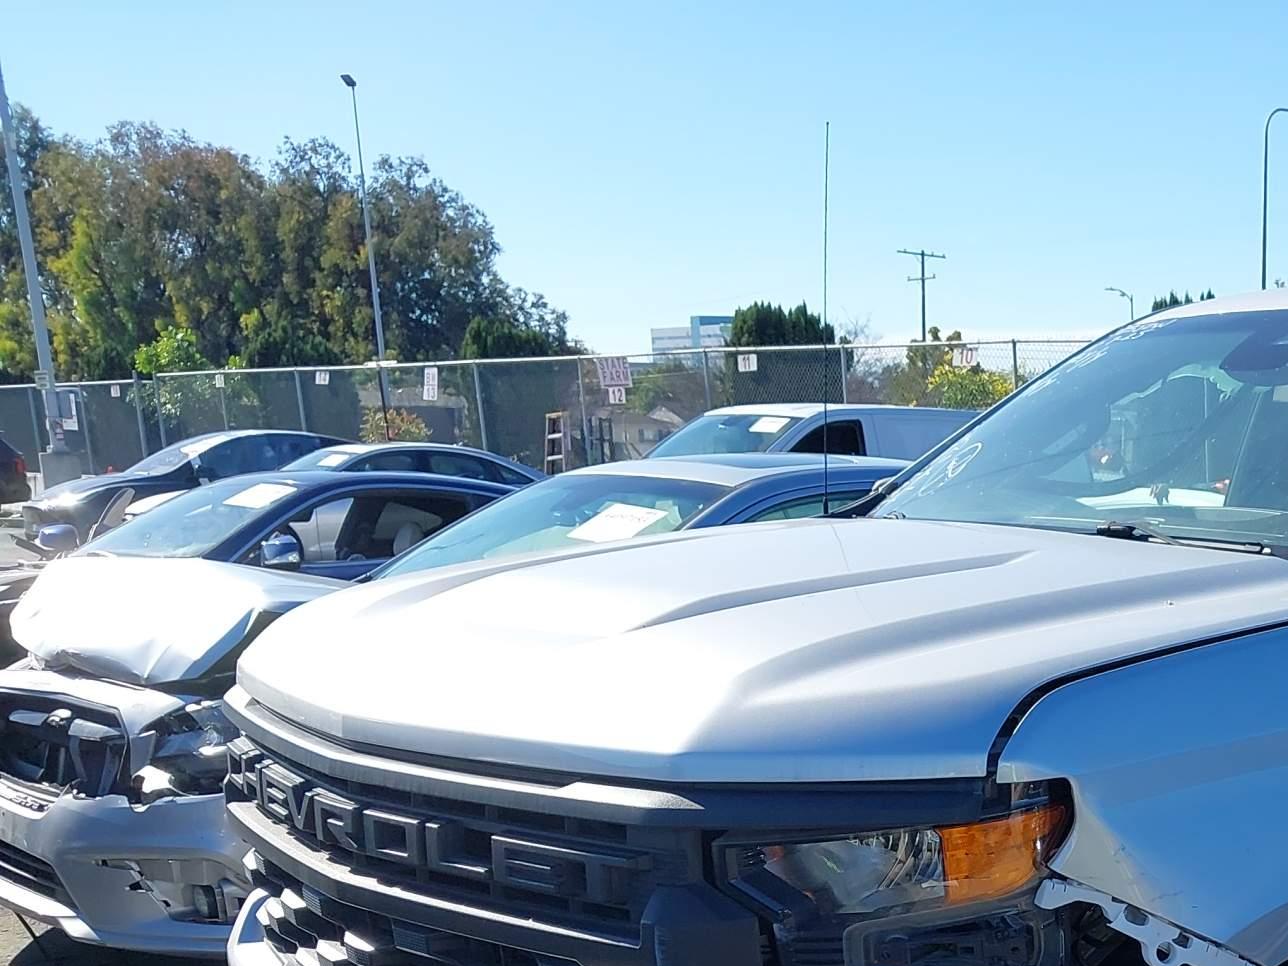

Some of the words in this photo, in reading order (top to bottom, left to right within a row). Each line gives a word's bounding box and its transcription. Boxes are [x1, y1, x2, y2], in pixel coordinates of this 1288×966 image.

[599, 358, 629, 370] STATE
[602, 370, 630, 384] FARM
[611, 388, 625, 402] 12
